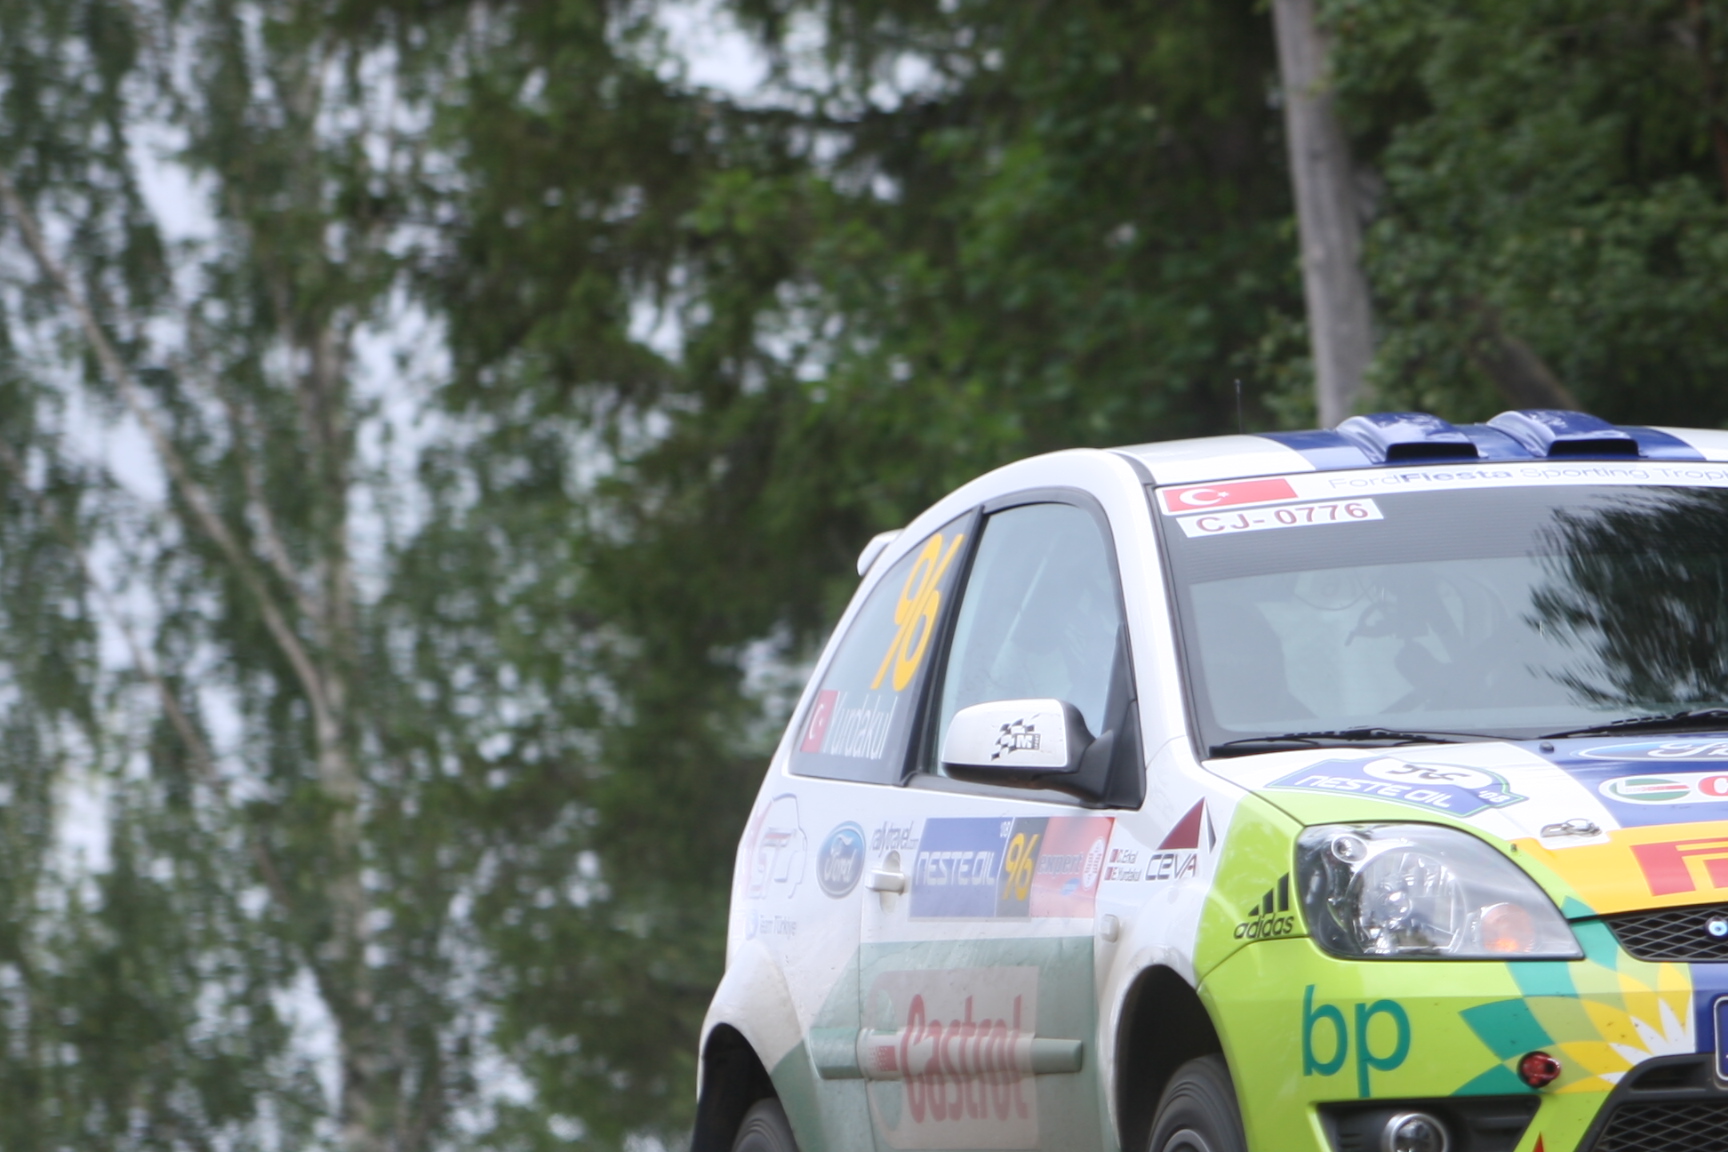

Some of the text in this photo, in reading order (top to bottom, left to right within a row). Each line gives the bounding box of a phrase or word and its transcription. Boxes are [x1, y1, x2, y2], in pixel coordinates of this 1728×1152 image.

[1520, 467, 1649, 481] Sporting
[869, 532, 965, 692] 96
[823, 690, 898, 760] Yurdakul
[1294, 775, 1412, 798] NESTE
[1404, 789, 1454, 808] OIL
[823, 834, 858, 883] Ford
[915, 851, 996, 886] NESTE OIL
[1002, 832, 1040, 902] 96
[1036, 850, 1085, 878] expert
[1145, 853, 1197, 881] CEVA
[1233, 914, 1294, 940] adidas
[901, 994, 1029, 1123] Castrol
[1302, 983, 1411, 1098] bp
